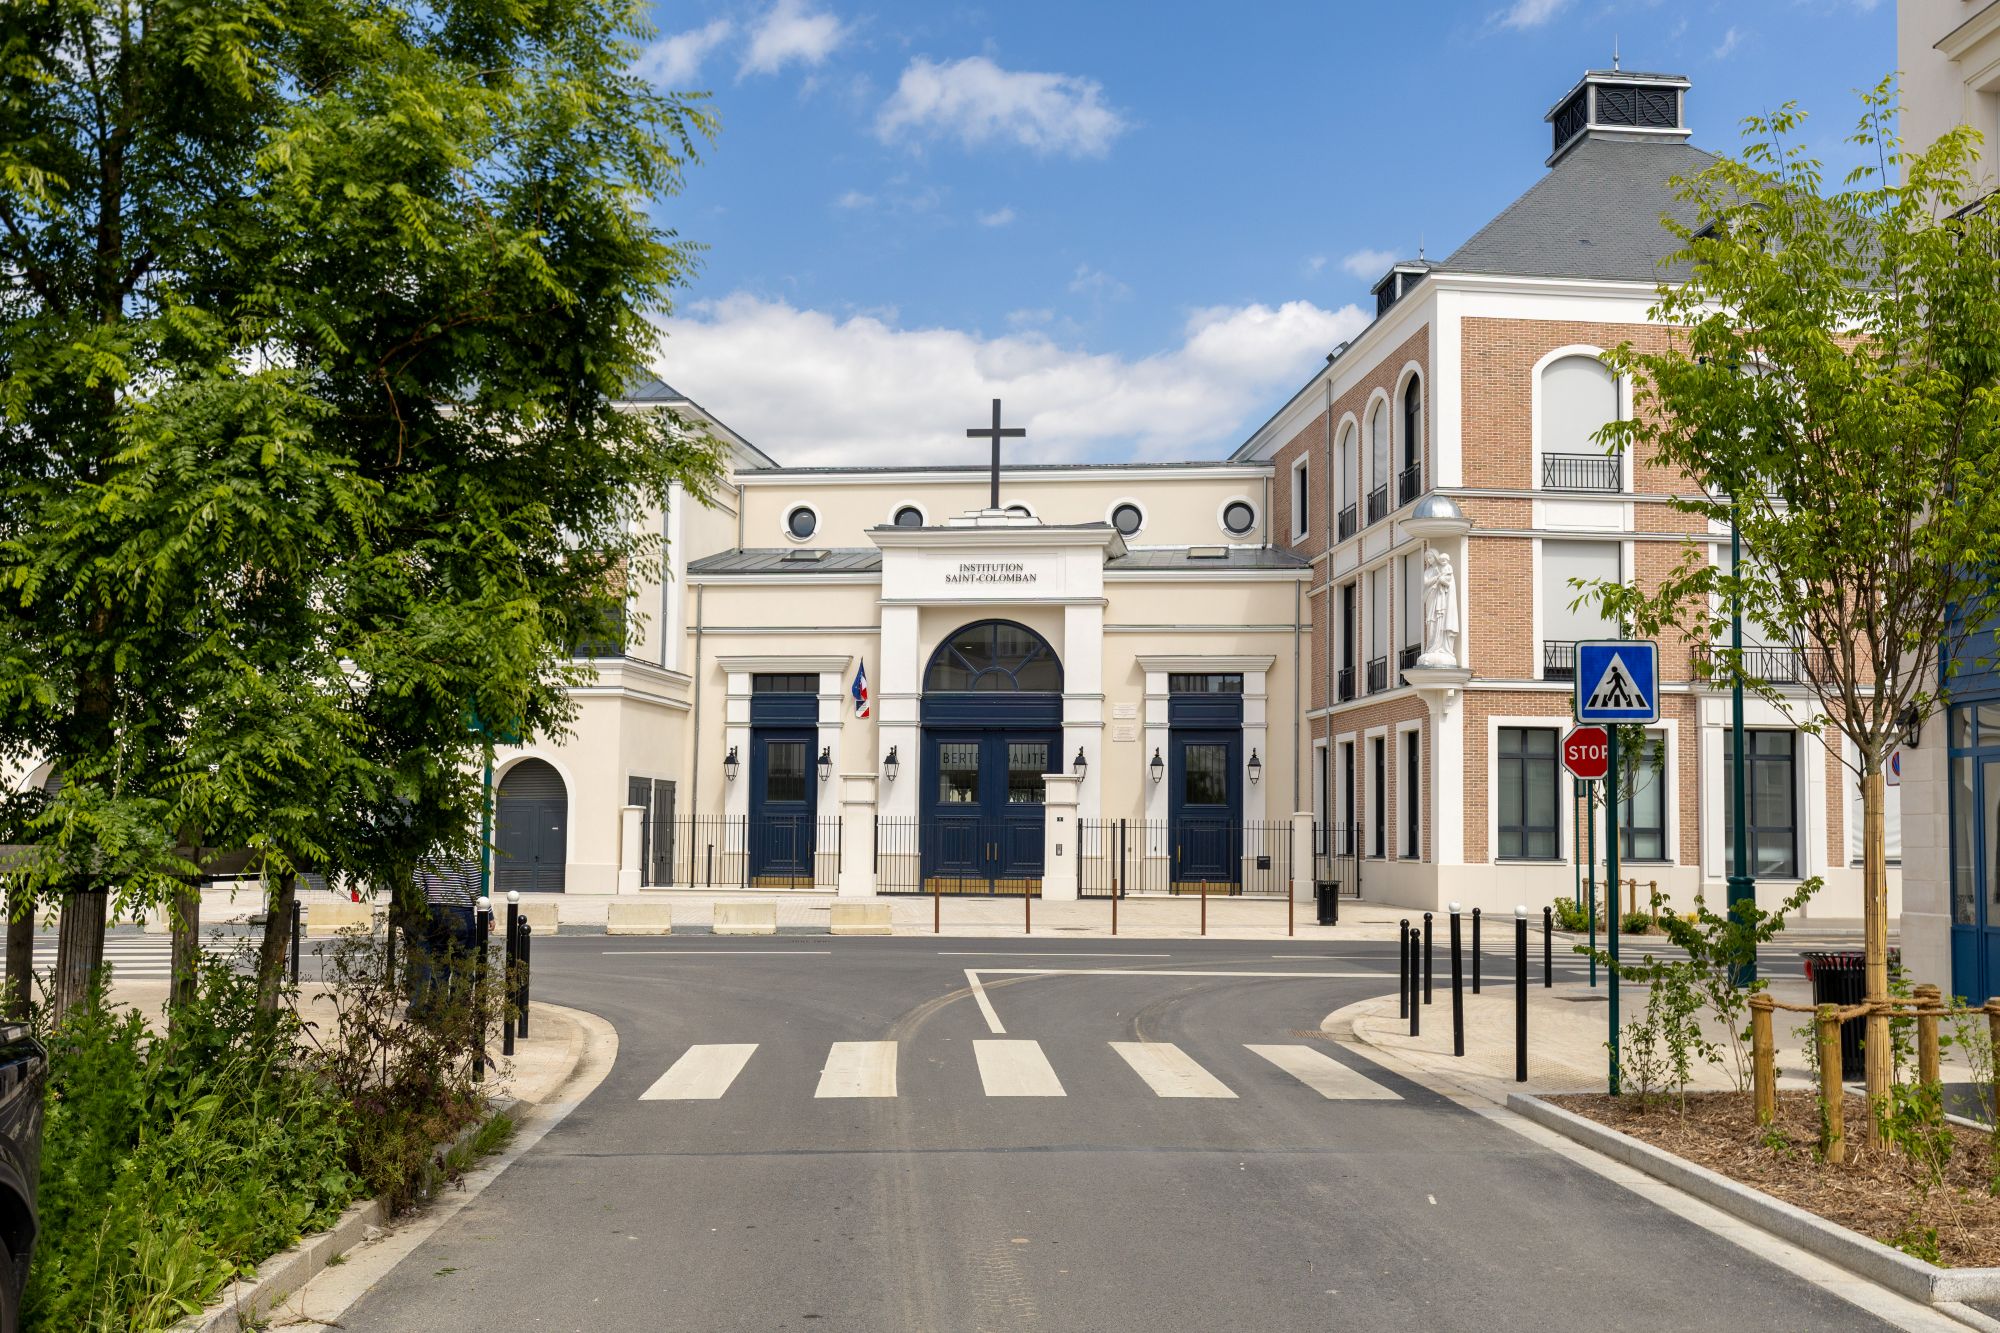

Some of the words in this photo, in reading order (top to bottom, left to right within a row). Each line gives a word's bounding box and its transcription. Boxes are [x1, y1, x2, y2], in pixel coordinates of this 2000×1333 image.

[959, 563, 1024, 572] INSTITUTION
[1008, 750, 1047, 764] ALITÉ
[1568, 744, 1608, 760] STOP
